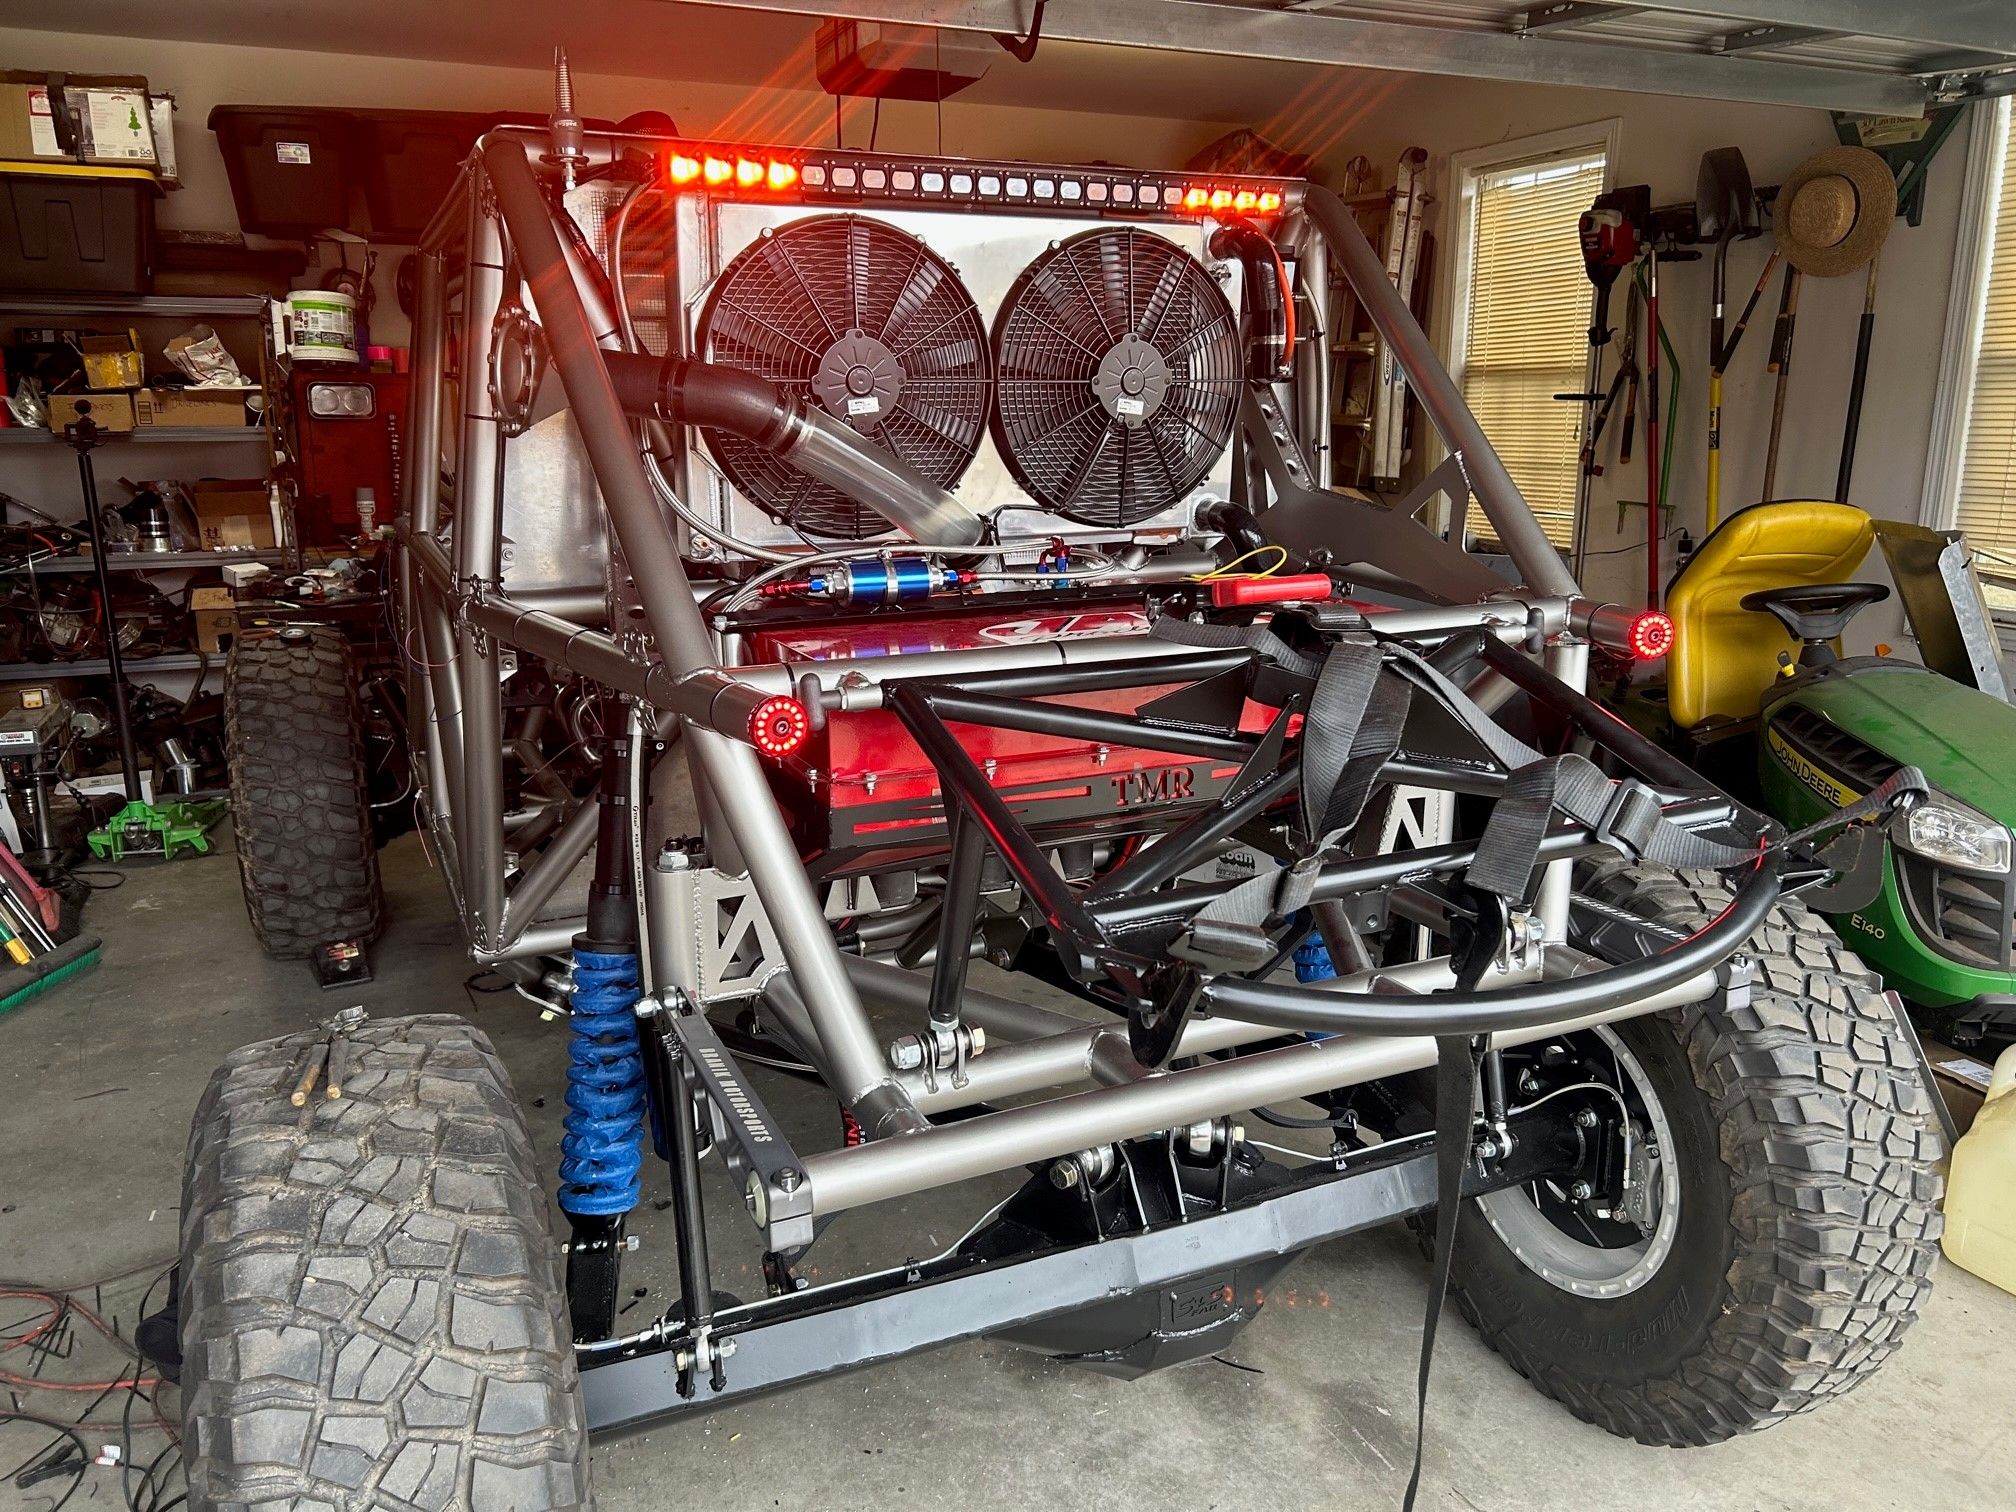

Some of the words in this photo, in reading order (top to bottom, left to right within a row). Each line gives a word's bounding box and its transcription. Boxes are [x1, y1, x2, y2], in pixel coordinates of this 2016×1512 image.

[1111, 767, 1195, 806] TMR
[1776, 741, 1800, 776] JOHN
[1801, 763, 1841, 804] DEERE
[1850, 913, 1885, 939] E140
[698, 1047, 732, 1078] BRANIK
[718, 1080, 773, 1142] MOTORSPORTS
